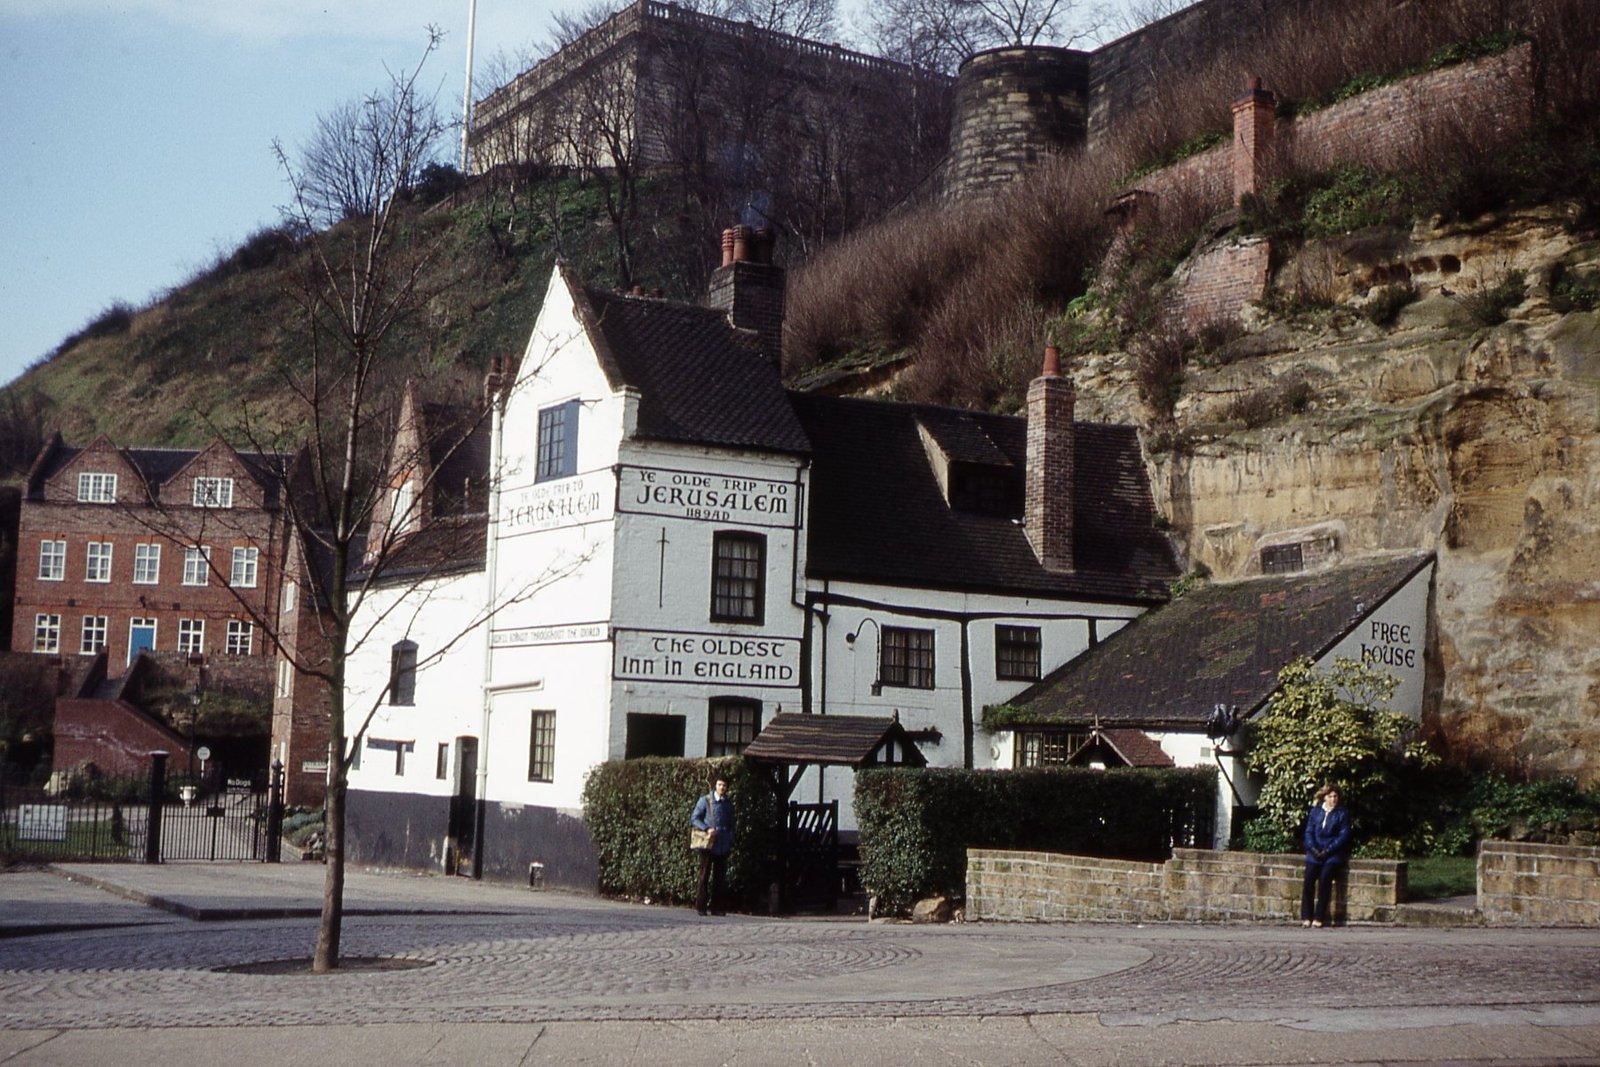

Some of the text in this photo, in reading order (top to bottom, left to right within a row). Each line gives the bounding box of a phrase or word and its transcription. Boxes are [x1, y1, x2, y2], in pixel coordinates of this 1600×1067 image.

[639, 470, 788, 495] YE OLDE TRIP TO
[507, 491, 600, 527] JERUSALEM
[636, 484, 788, 514] JERUSALEM
[1371, 620, 1411, 645] FREE
[702, 638, 785, 658] OLDEST
